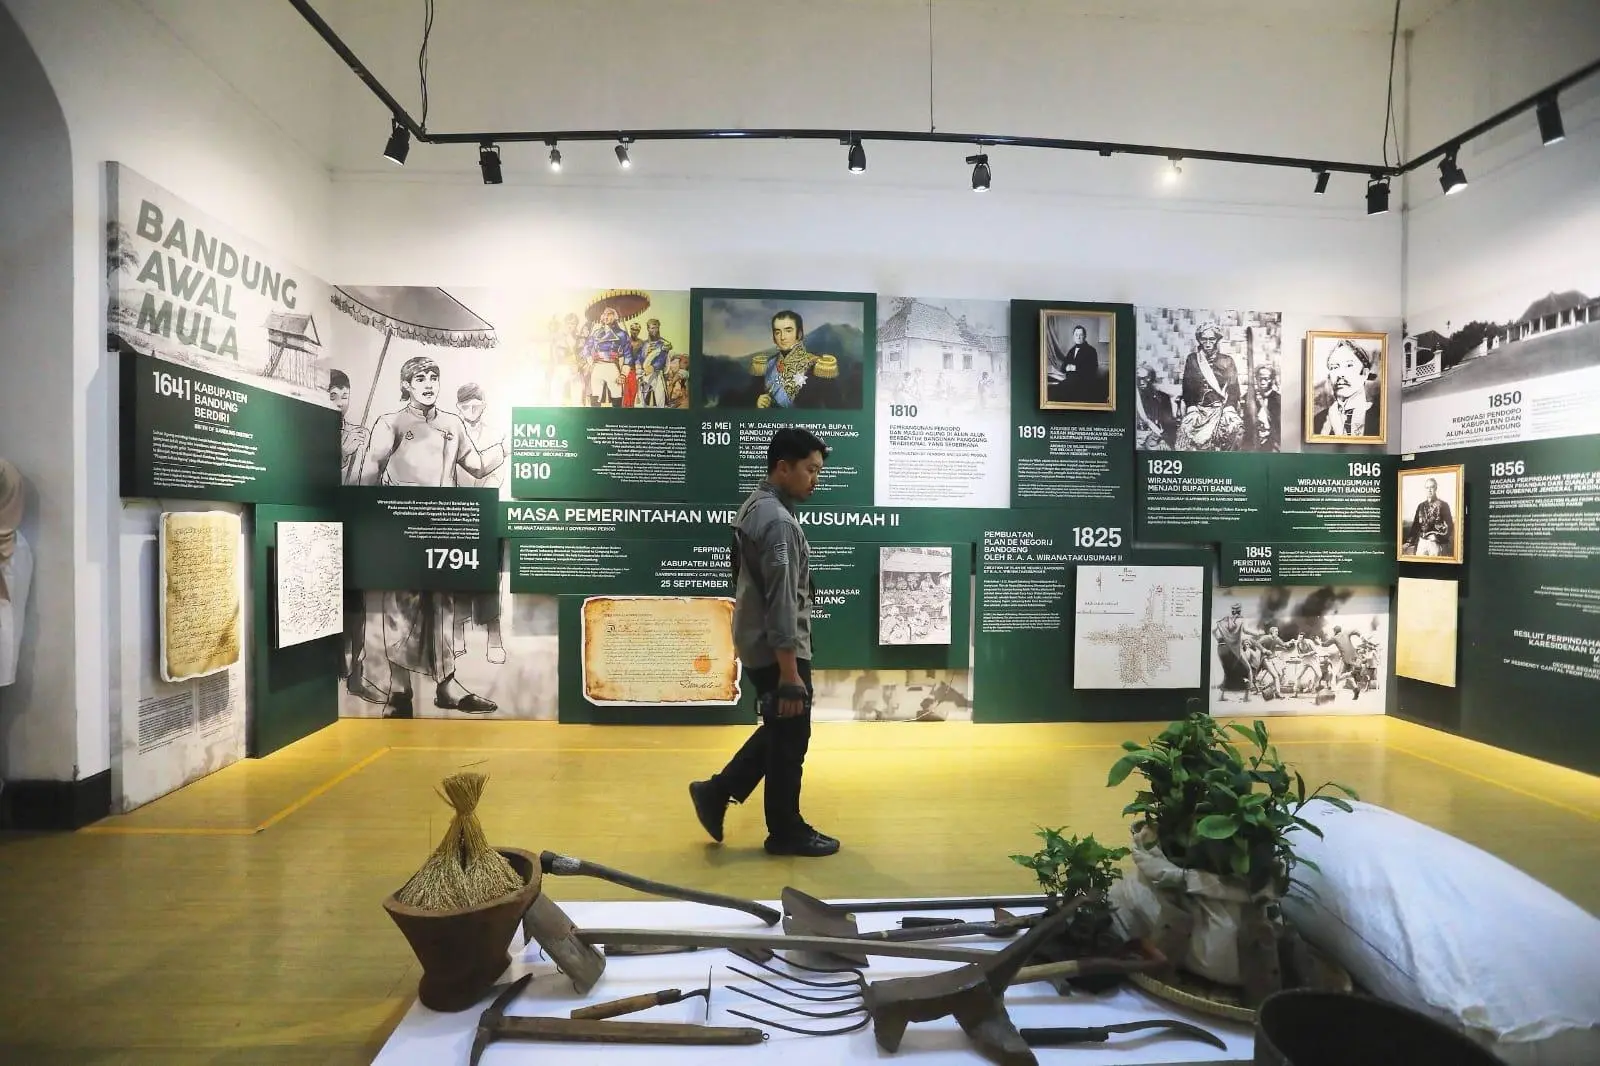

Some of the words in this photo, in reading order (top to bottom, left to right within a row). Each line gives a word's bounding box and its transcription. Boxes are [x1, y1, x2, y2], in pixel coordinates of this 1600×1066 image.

[136, 199, 298, 310] BANDUNG
[136, 250, 237, 320] AWAL
[136, 293, 239, 361] MULA
[152, 371, 191, 401] 1641
[194, 381, 248, 404] KABUPATEN
[194, 393, 238, 413] BANDUNG
[1488, 390, 1522, 409] 1850
[194, 407, 230, 423] BERDIRI
[889, 404, 918, 418] 1810
[1452, 413, 1485, 424] RENOVASI
[1487, 407, 1522, 418] PENDOPO
[701, 422, 713, 430] 25
[715, 422, 732, 430] MEI
[1461, 418, 1504, 429] KABUPATEN
[1505, 415, 1522, 423] DAN
[513, 423, 541, 438] KM
[545, 424, 556, 438] 0
[810, 430, 859, 438] ANMUNCANG
[1018, 425, 1046, 439] 1819
[1446, 427, 1484, 438] ALUN-ALUN
[1485, 421, 1521, 433] BANDUNG
[513, 438, 569, 448] DAENDELS
[701, 432, 731, 446] 1810
[513, 462, 551, 480] 1810
[1147, 459, 1183, 475] 1829
[1347, 462, 1381, 476] 1846
[1489, 460, 1525, 477] 1856
[1147, 477, 1225, 485] WIRANATAKUSUMAH
[1514, 481, 1547, 489] PRIANGAN
[1564, 478, 1595, 486] CIANJUR
[1517, 474, 1561, 483] PERPINDAHAN
[1562, 472, 1590, 480] TEMPAT
[1591, 471, 1600, 479] KE
[1505, 487, 1538, 495] GUBERNUR
[507, 507, 560, 522] MASA
[565, 508, 702, 524] PEMERINTAHAN
[891, 513, 900, 527] II
[984, 538, 1006, 546] PLAN
[1072, 526, 1122, 548] 1825
[1245, 546, 1272, 558] 1845
[1233, 559, 1272, 567] PERISTIWA
[1239, 566, 1272, 574] MUNADA
[660, 579, 672, 588] 25
[673, 580, 729, 588] SEPTEMBER
[814, 596, 846, 605] RIANG
[1513, 629, 1545, 640] BESLUIT
[1546, 633, 1600, 648] PERPINDAHA
[1528, 639, 1587, 653] KARESIDENAN
[1589, 647, 1600, 655] DA
